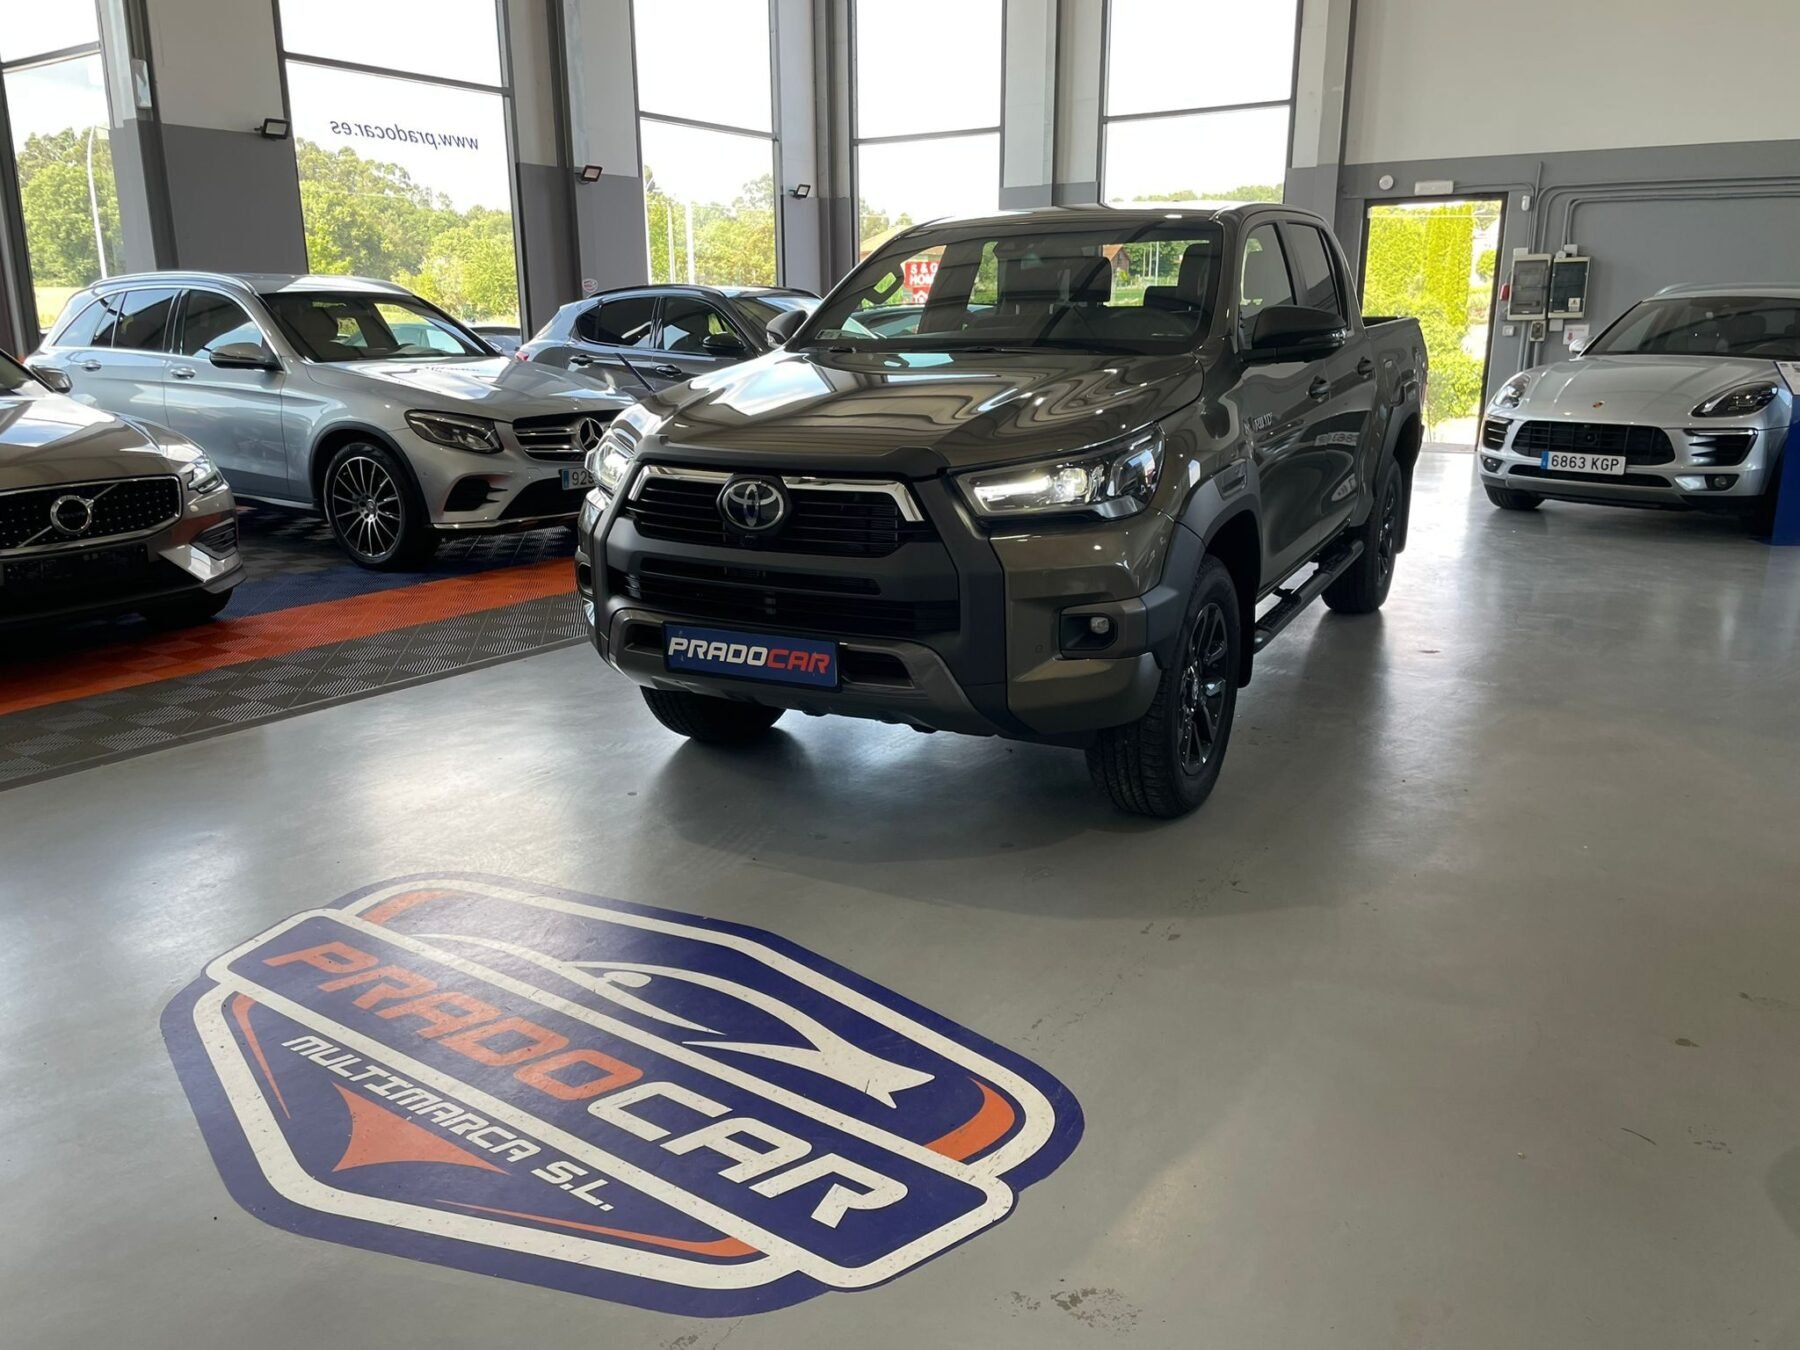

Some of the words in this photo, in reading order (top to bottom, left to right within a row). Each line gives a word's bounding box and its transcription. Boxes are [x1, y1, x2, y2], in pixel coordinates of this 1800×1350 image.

[1551, 454, 1586, 469] 6863
[1591, 457, 1620, 472] KGP
[668, 637, 831, 674] PRADOCAR
[262, 941, 909, 1229] PRADOCAR
[281, 1035, 542, 1163] MULTIMARCA
[531, 1160, 615, 1212] S.L.
